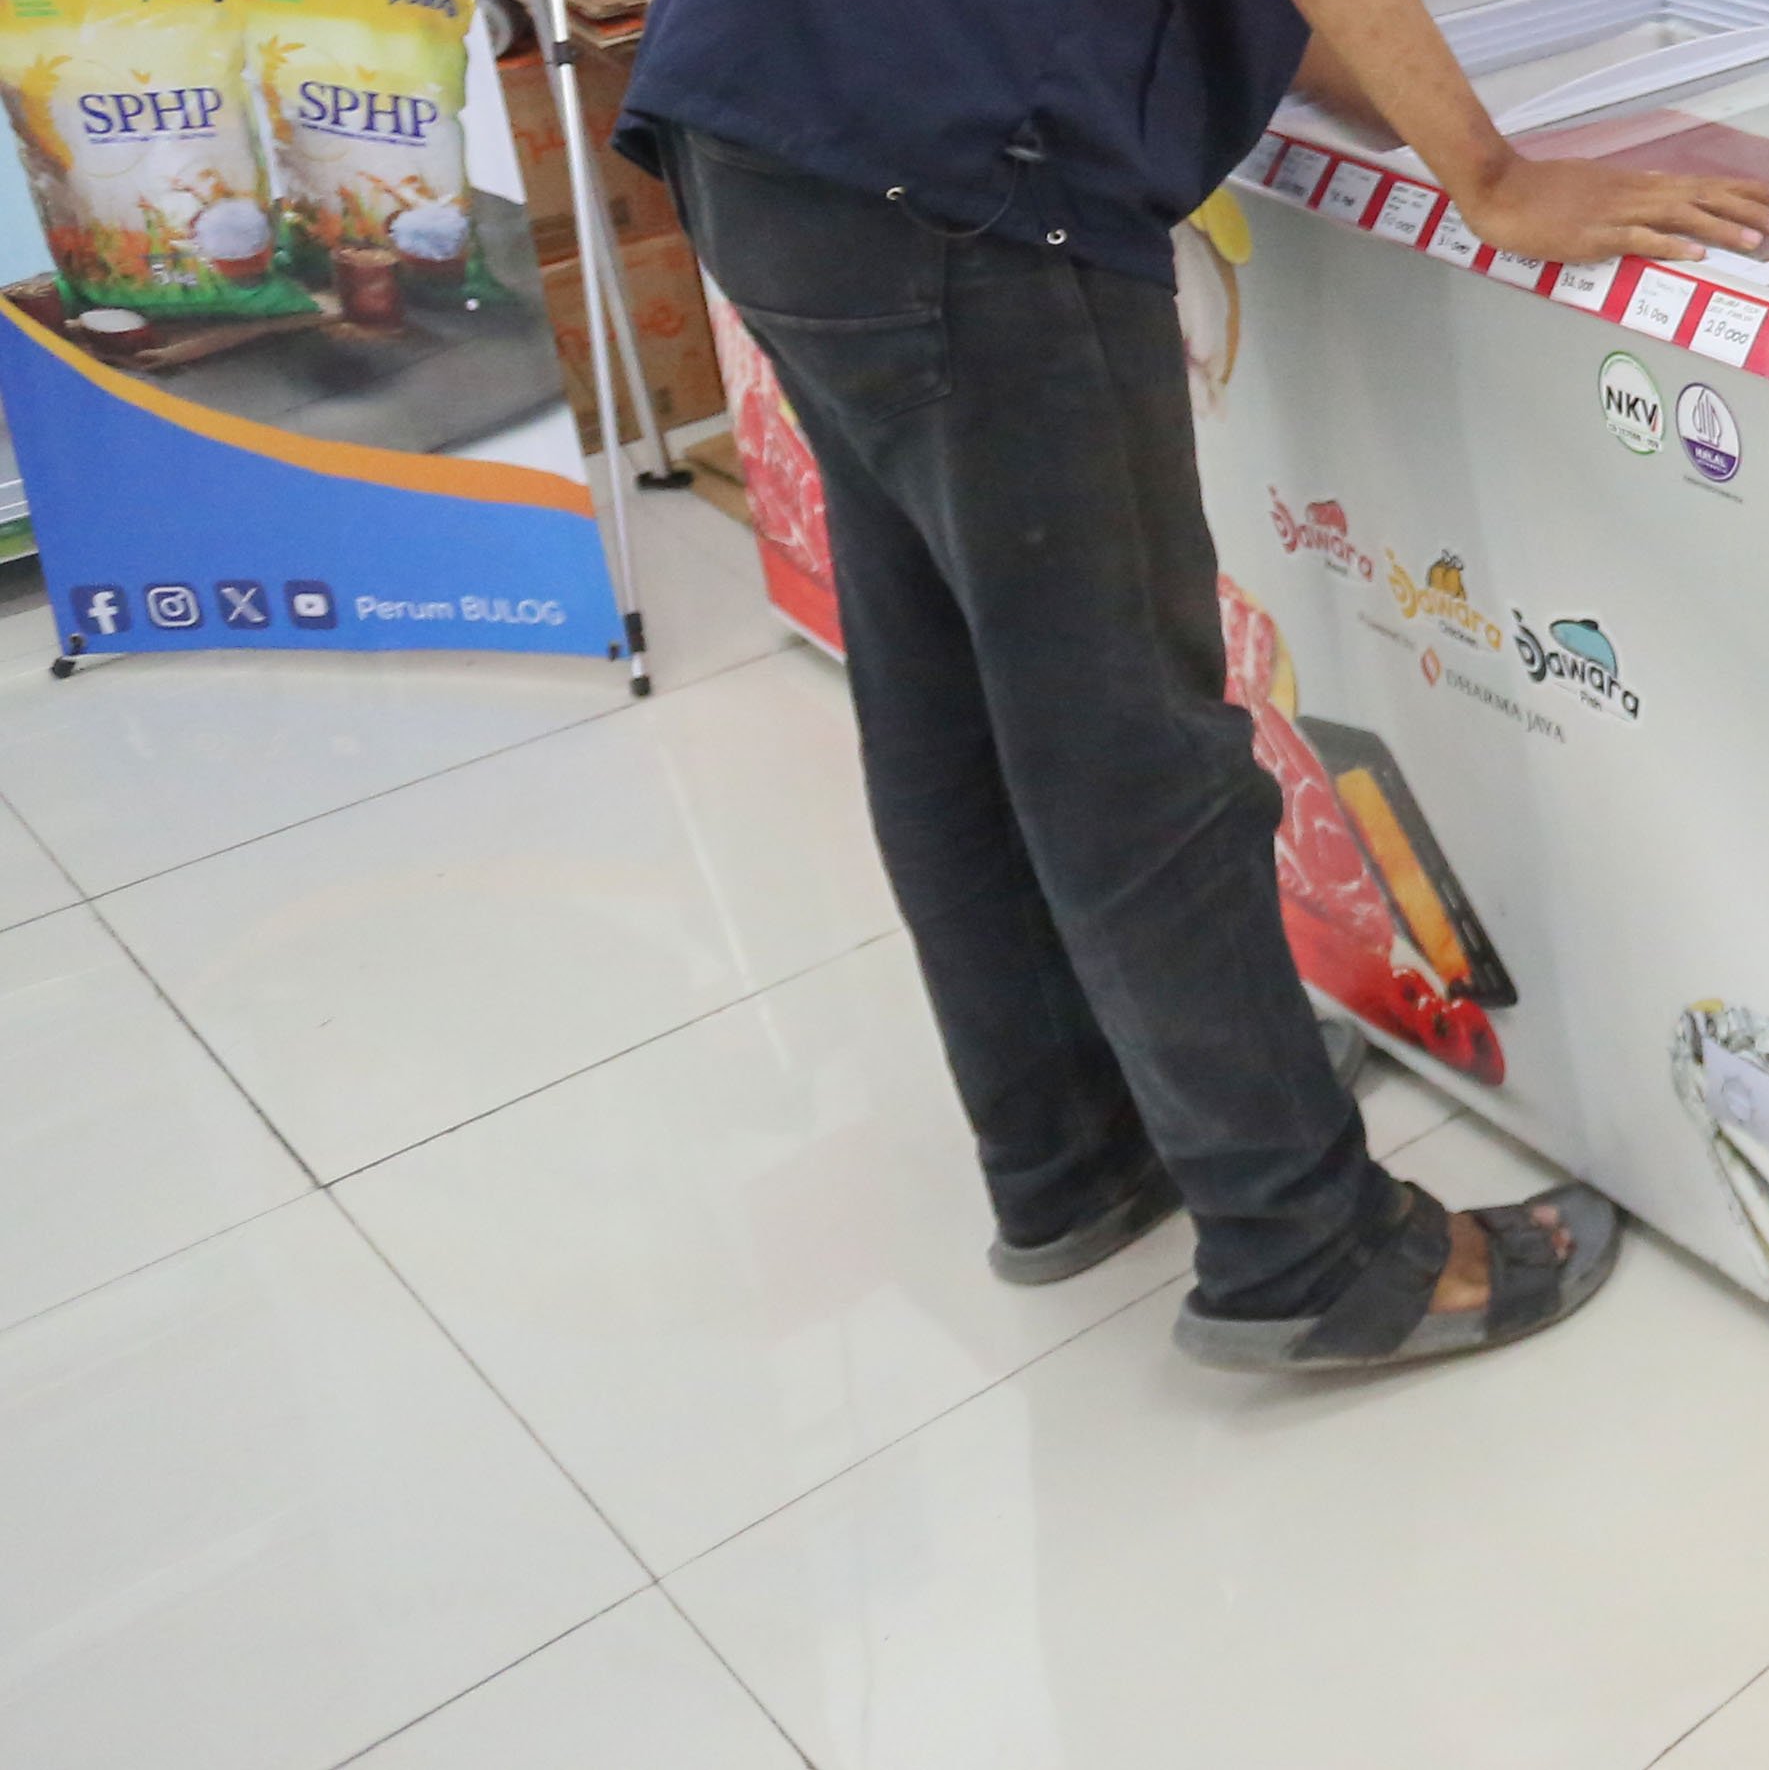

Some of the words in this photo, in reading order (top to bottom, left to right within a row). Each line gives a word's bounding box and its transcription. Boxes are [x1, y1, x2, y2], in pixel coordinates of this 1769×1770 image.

[78, 87, 223, 135] SPHP
[299, 81, 438, 139] SPHP
[1606, 385, 1658, 427] NKV
[355, 595, 453, 621] Perum
[459, 595, 566, 627] BULOG
[1445, 669, 1522, 723] DHARMA
[1527, 709, 1566, 744] JAYA
